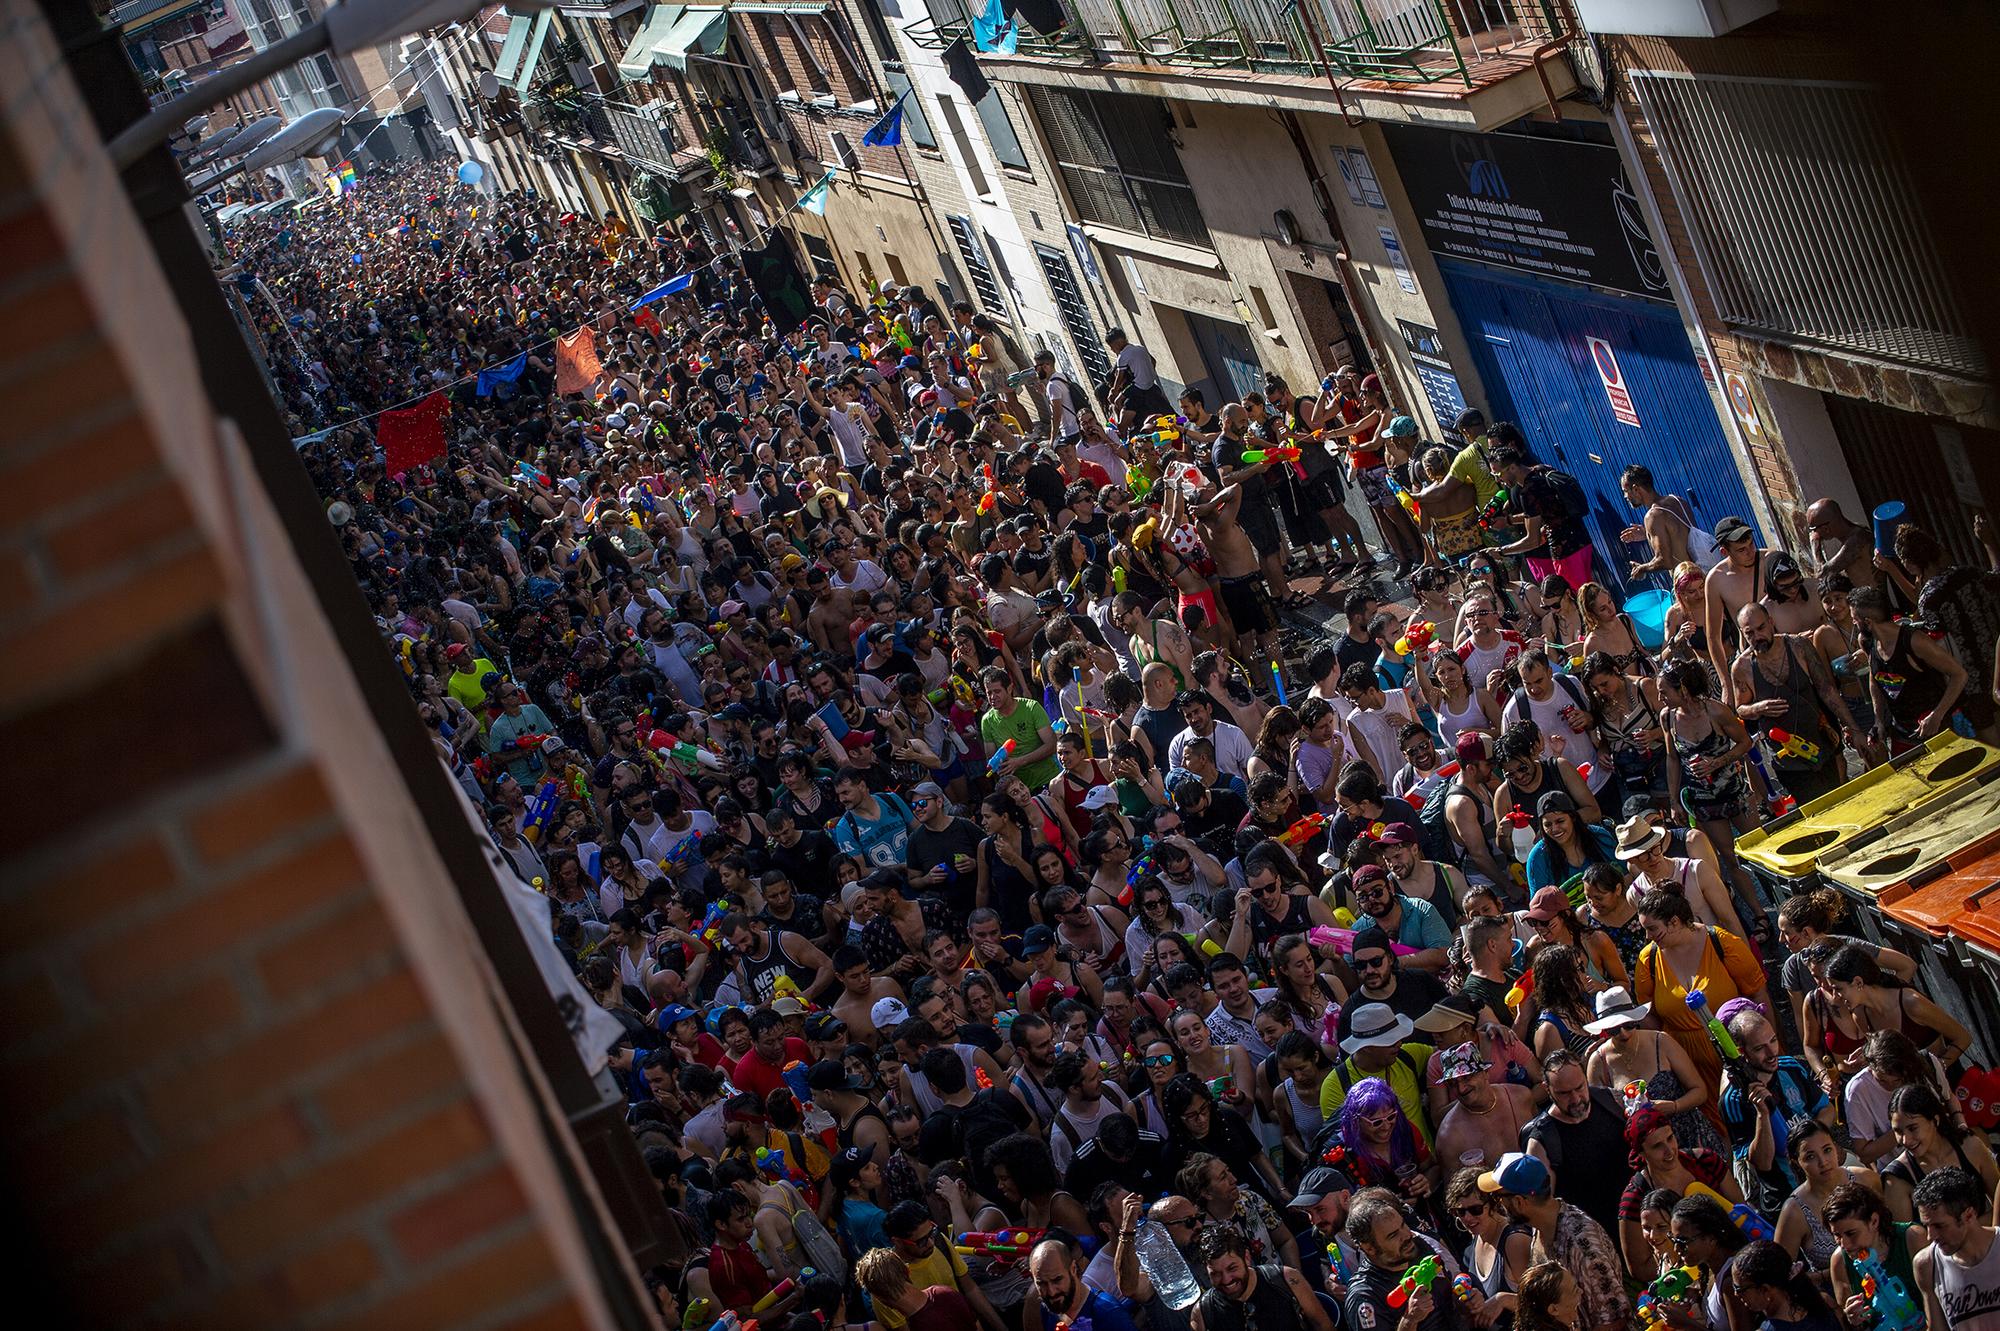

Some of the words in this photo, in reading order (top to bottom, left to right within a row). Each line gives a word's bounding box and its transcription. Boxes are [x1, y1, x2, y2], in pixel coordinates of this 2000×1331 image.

[1446, 193, 1468, 209] Taller
[1466, 197, 1476, 211] de
[1503, 203, 1543, 222] Multimarca
[753, 964, 786, 993] NEW
